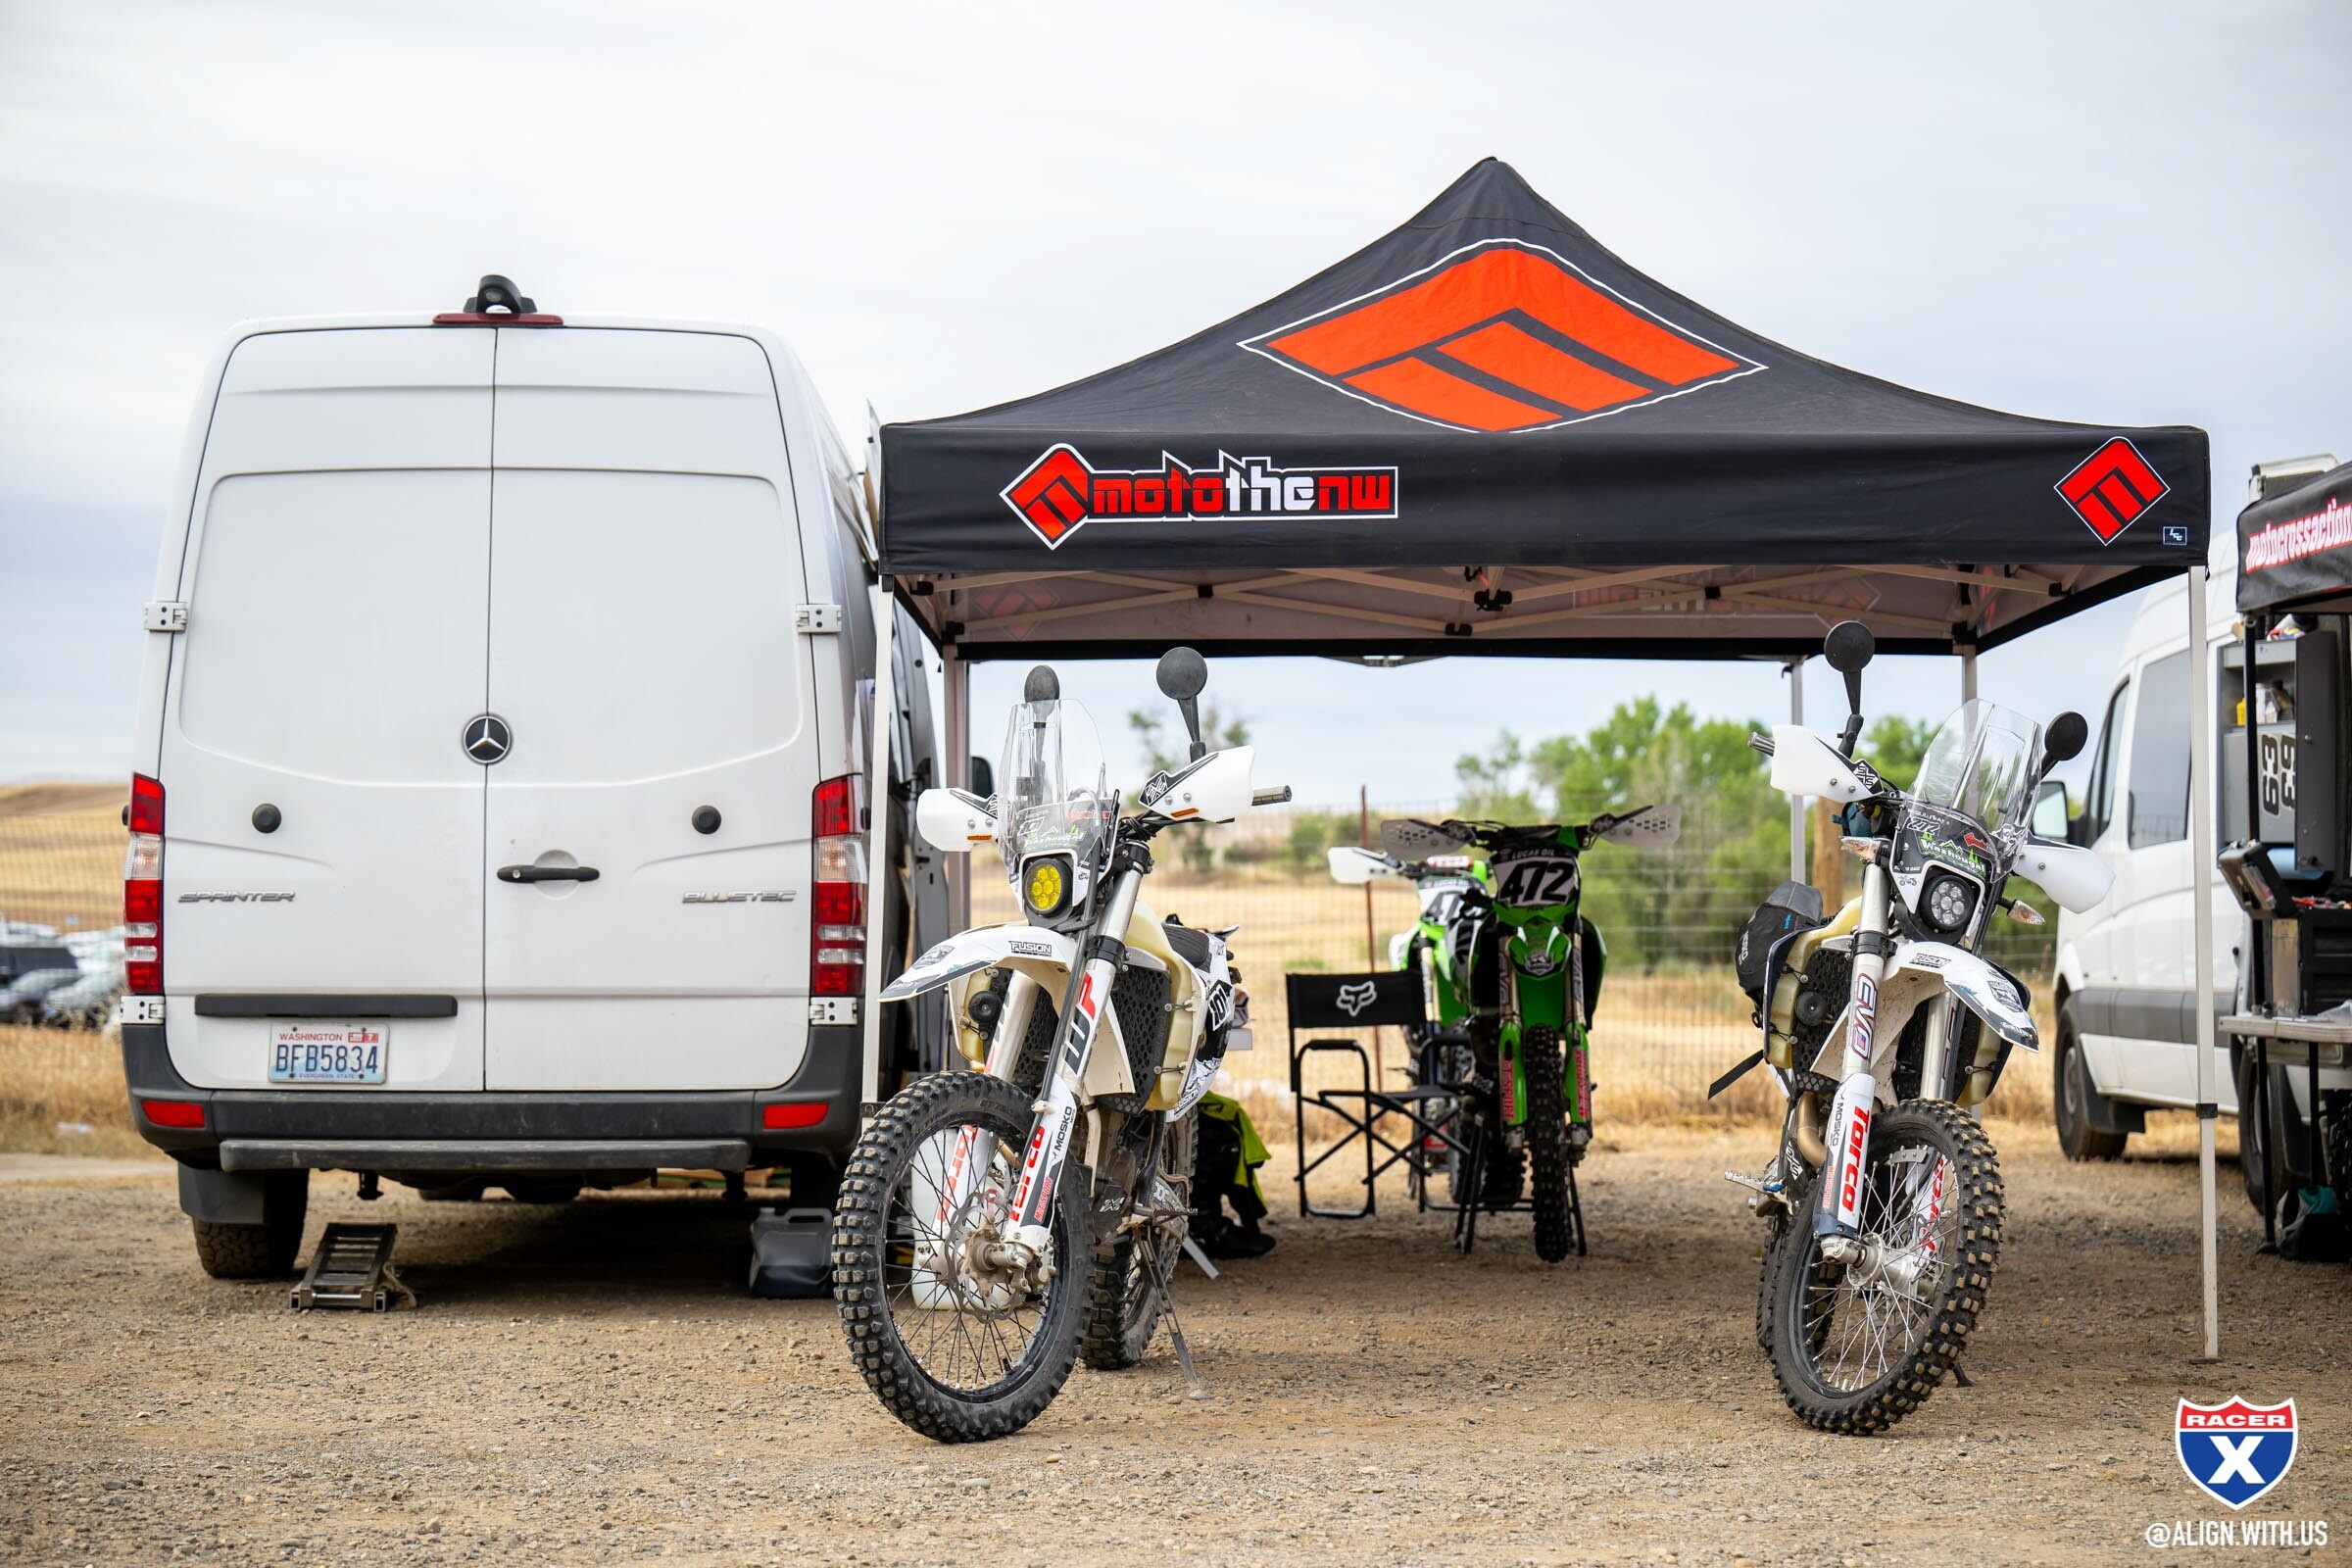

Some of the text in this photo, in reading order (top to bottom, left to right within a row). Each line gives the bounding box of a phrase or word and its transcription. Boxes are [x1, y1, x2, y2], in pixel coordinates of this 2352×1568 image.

[176, 891, 297, 904] SPRINTER
[682, 890, 797, 904] BLUETEC
[1499, 860, 1574, 903] 472
[1009, 940, 1053, 955] FUSION
[1851, 973, 1878, 1060] EVO
[279, 1033, 343, 1042] WASHINGTON
[275, 1045, 378, 1073] BFB5834
[1057, 1105, 1073, 1152] MOSKO
[1832, 1102, 1844, 1147] MOSKO
[1842, 1105, 1870, 1212] Torco
